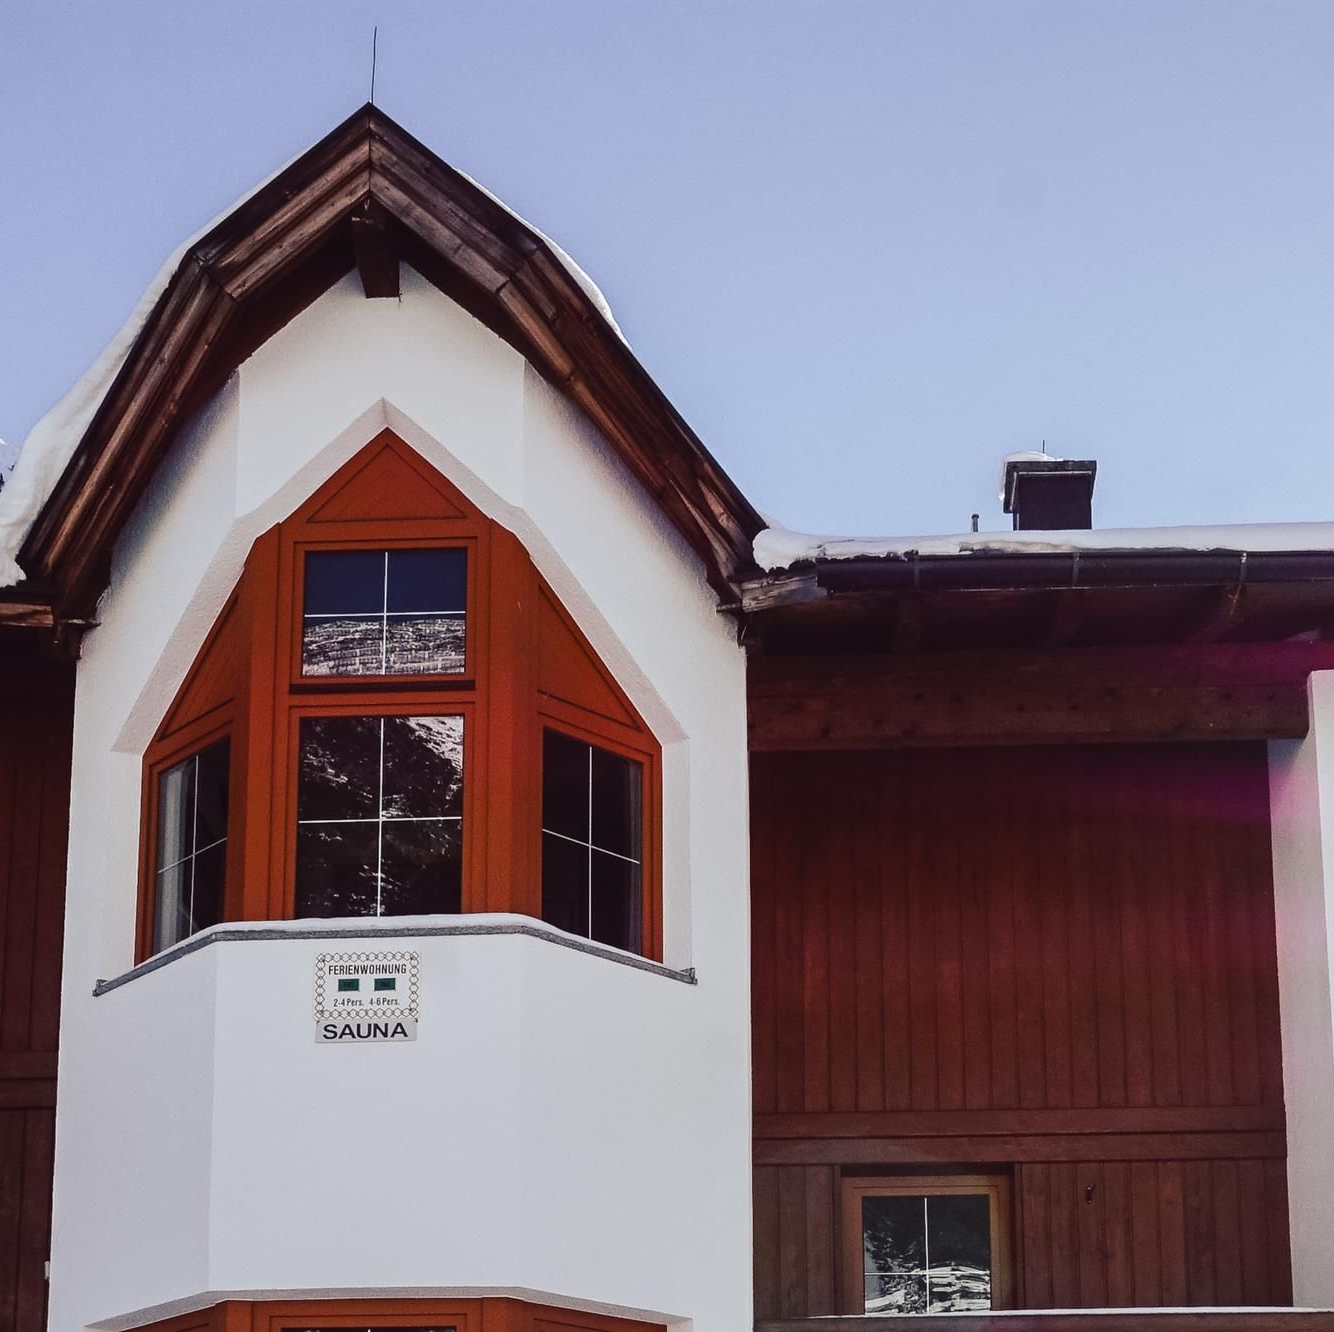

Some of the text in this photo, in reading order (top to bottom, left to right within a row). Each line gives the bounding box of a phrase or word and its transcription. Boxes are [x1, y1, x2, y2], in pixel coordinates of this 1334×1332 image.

[328, 964, 406, 975] FERIENWOHNUNG
[347, 998, 365, 1007] Pers.
[382, 997, 401, 1006] Pers.
[323, 1023, 408, 1039] SAUNA
